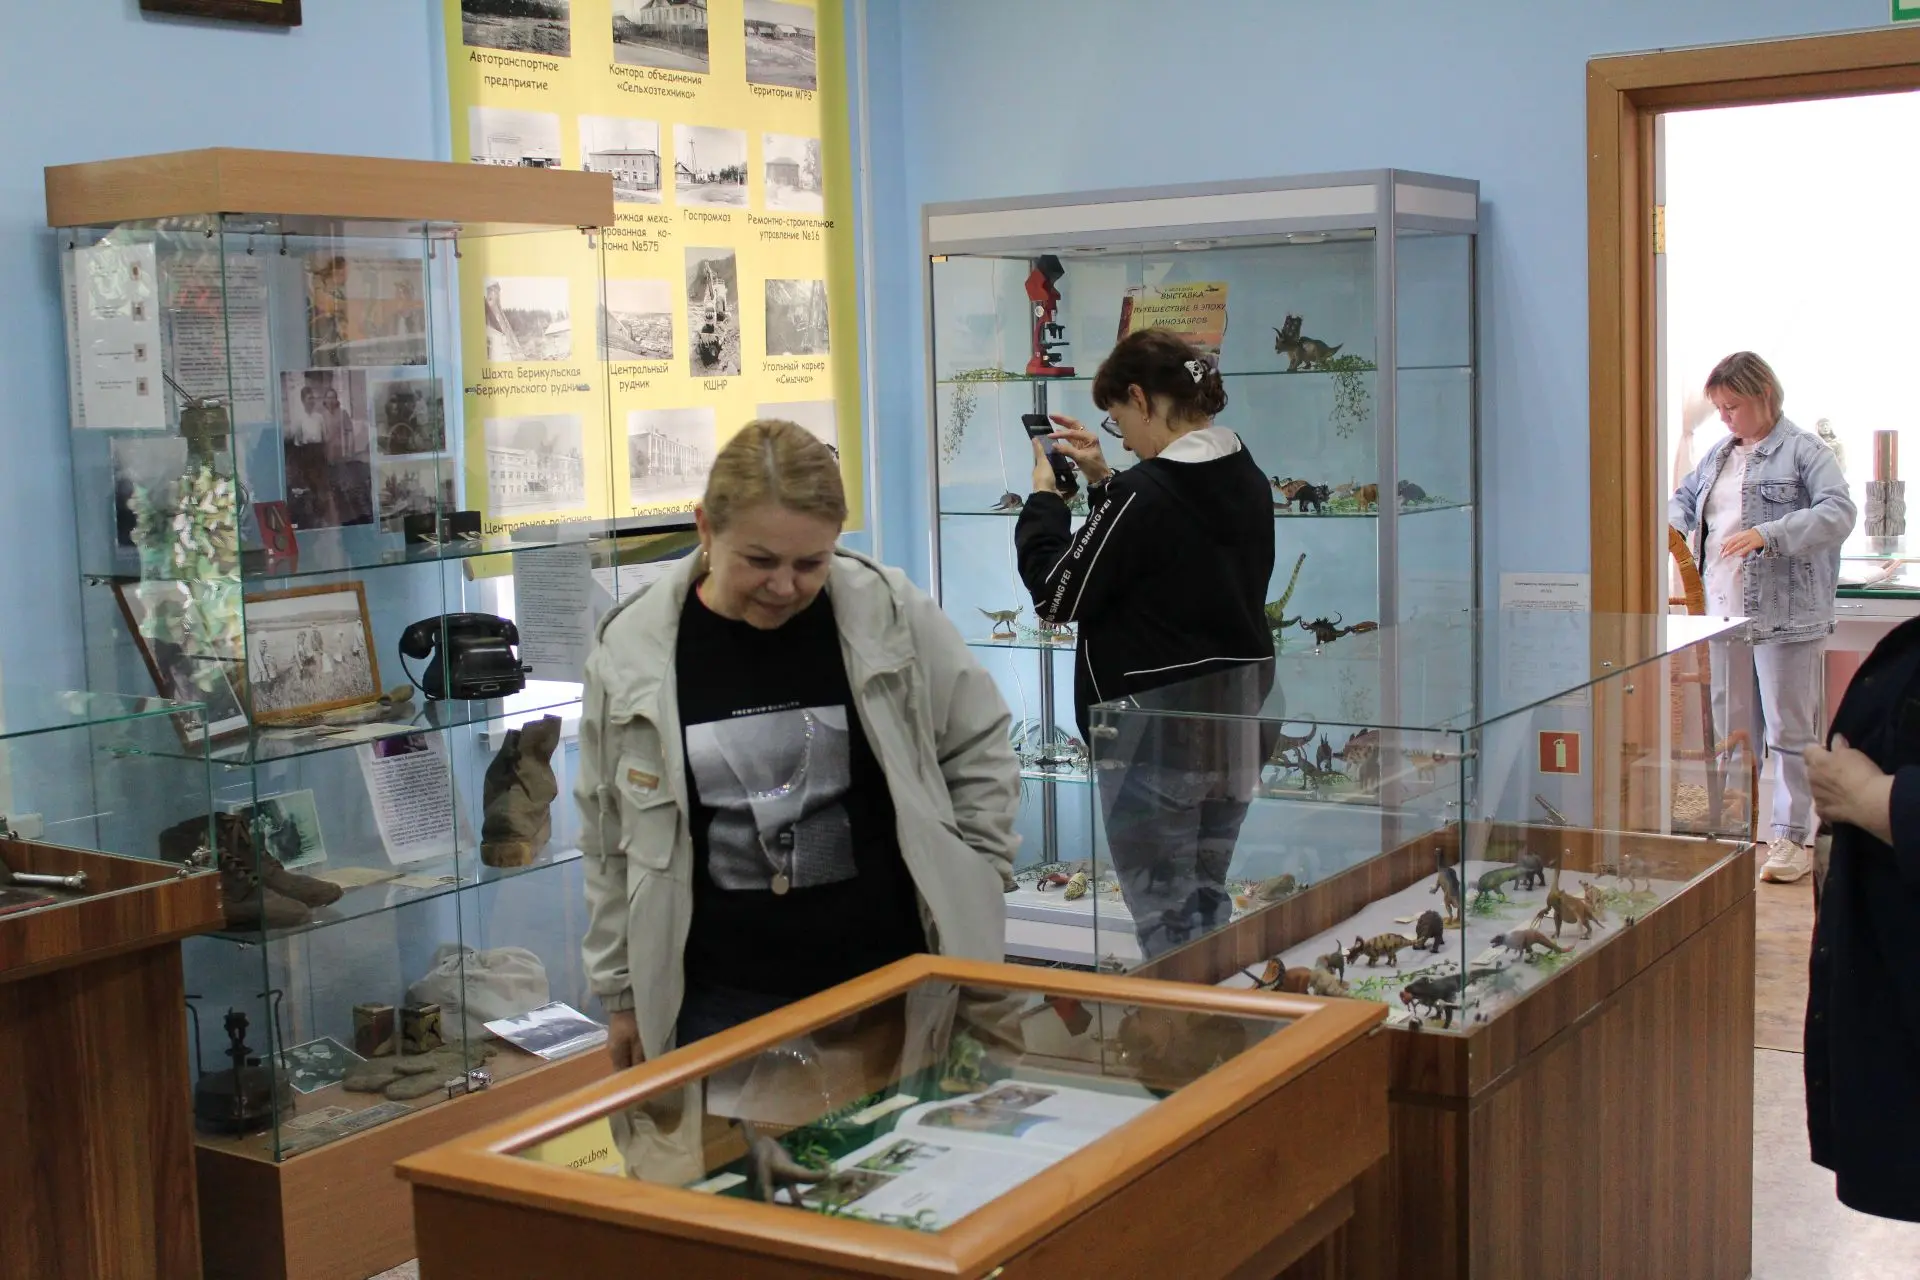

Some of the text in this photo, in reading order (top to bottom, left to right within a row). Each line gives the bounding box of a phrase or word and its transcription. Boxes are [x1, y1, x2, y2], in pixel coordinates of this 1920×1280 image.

[469, 50, 560, 72] Автотранспортное
[609, 63, 702, 85] Контора объединения
[484, 75, 549, 91] предприятие
[617, 81, 696, 99] «Сельхозтехника»
[748, 83, 793, 100] Территория
[647, 215, 673, 224] меха-
[683, 209, 731, 224] Госпромхоз
[747, 213, 835, 231] Ремонтно-строительное
[759, 229, 820, 242] управление №16
[632, 241, 659, 252] №575
[1160, 291, 1205, 300] ВЫСТАВКА
[1133, 304, 1190, 314] ПУТЕШЕСТВИЕ
[1200, 303, 1227, 311] ЭПОХУ
[1152, 317, 1208, 326] ДИНОЗАВРОВ
[610, 362, 669, 378] Центральный
[762, 360, 825, 372] Угольный карьер
[481, 366, 581, 382] Шахта Берикульская
[775, 374, 814, 384] «Смычка»
[475, 382, 584, 399] Берикульского рудни
[619, 380, 650, 392] рудник
[703, 380, 728, 391] КШНР
[1073, 544, 1084, 559] GU
[1081, 513, 1102, 545] SHANG
[1050, 584, 1066, 614] SHANG
[1060, 569, 1072, 585] FEI
